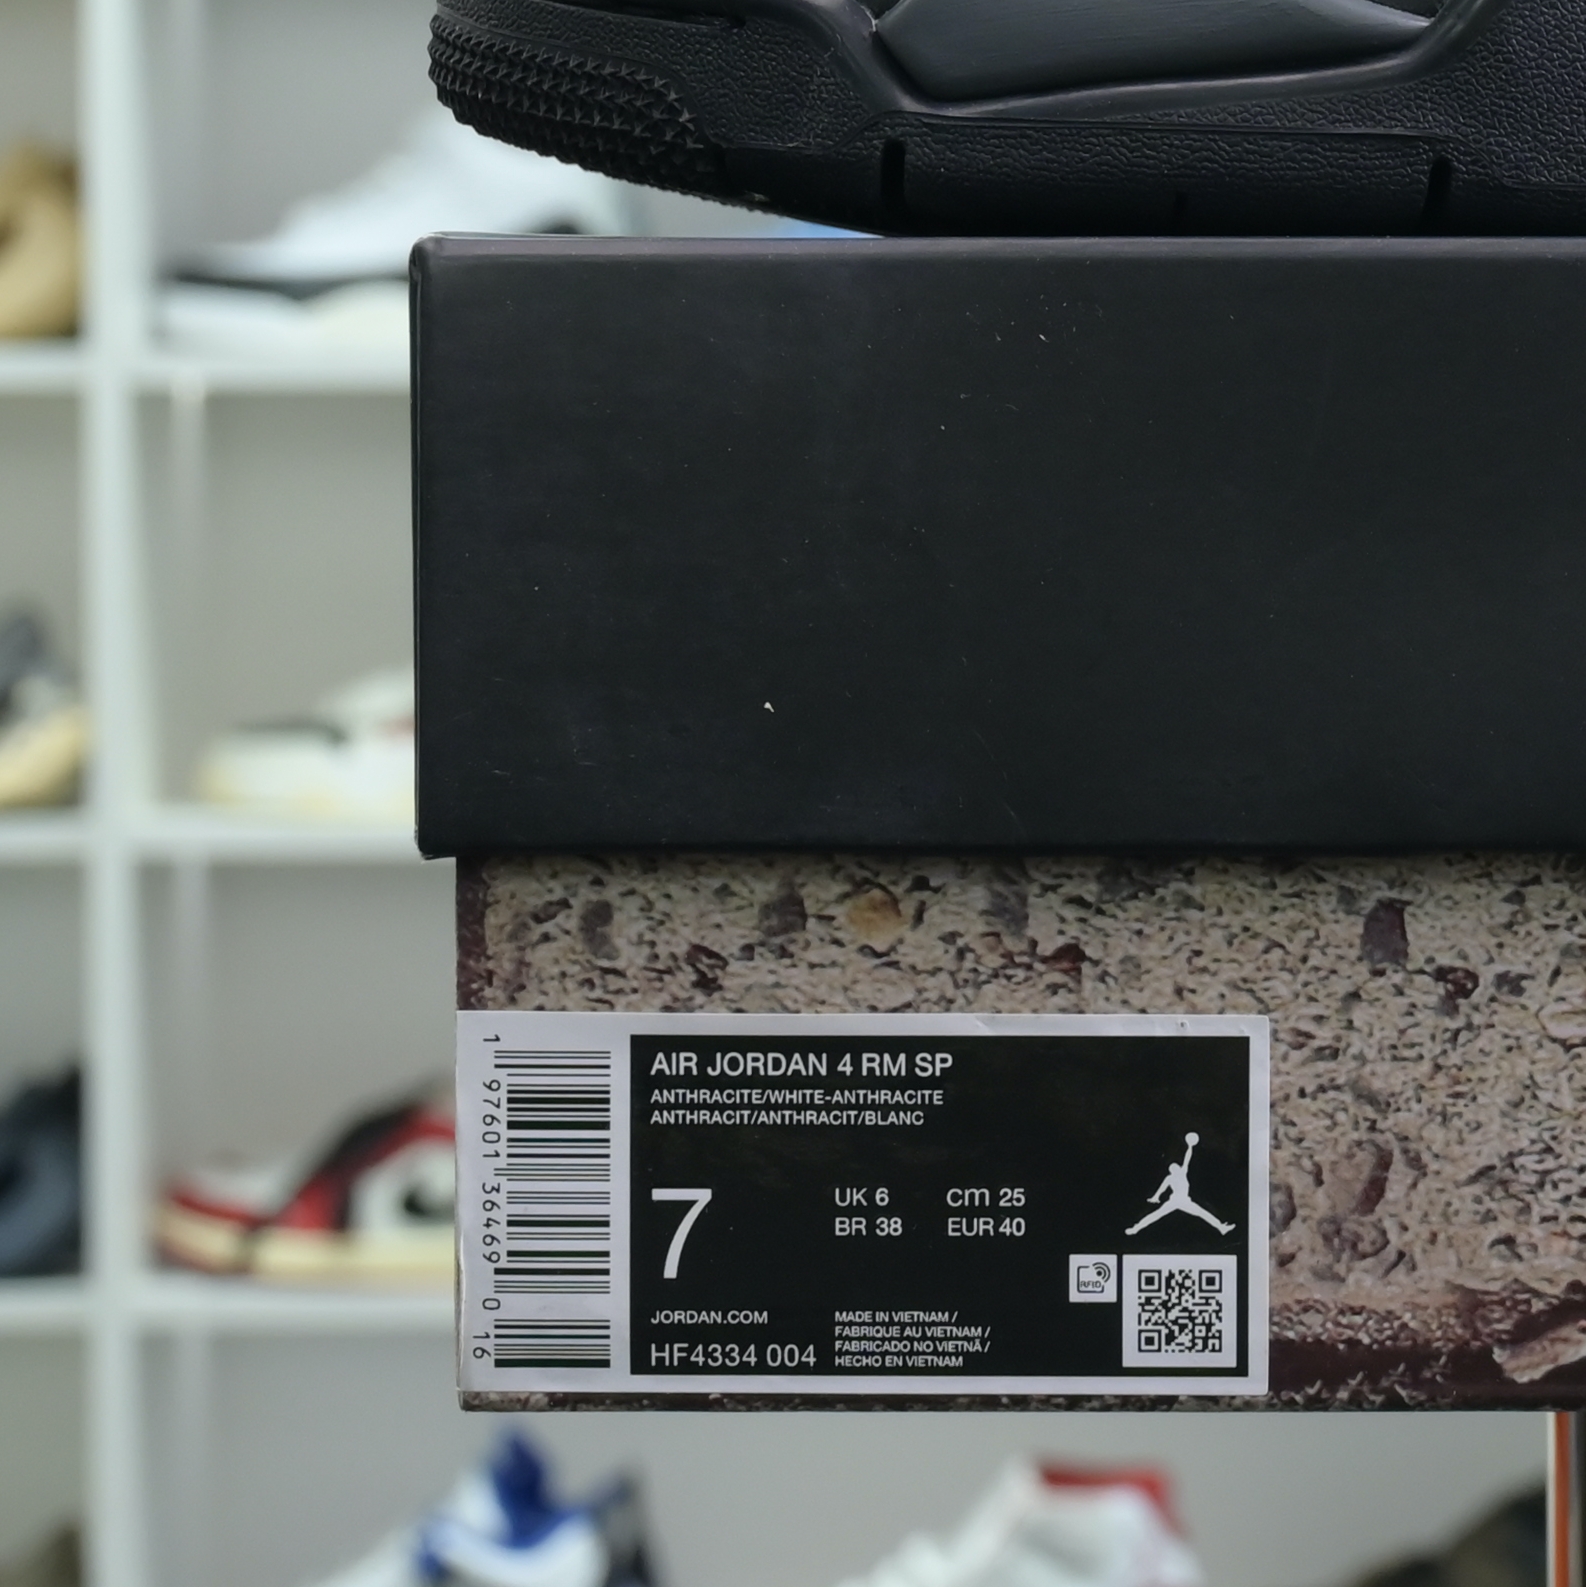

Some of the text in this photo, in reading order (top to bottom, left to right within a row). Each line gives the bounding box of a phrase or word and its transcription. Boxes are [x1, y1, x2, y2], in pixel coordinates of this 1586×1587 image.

[482, 1034, 501, 1042] 1
[649, 1051, 953, 1078] AIR JORDAN 4 RM SP
[650, 1088, 944, 1105] ANTHRACITE/WHITE-ANTHRACITE
[650, 1109, 925, 1126] ANTHRACIT/ANTHRACIT/BLANC
[482, 1079, 502, 1263] 97601 36469
[834, 1187, 890, 1207] UK 6
[998, 1187, 1026, 1207] 25
[651, 1187, 713, 1280] 7
[834, 1216, 903, 1237] BR 38
[947, 1216, 1026, 1237] EUR 40
[482, 1297, 501, 1311] 0
[650, 1309, 768, 1325] JORDAN.COM
[834, 1311, 873, 1323] MADE
[875, 1311, 889, 1323] IN
[892, 1311, 949, 1323] VIETNAM
[834, 1325, 901, 1338] FABRIQUE
[903, 1325, 922, 1338] AU
[925, 1325, 982, 1338] VIETNAM
[472, 1331, 492, 1359] 16
[834, 1340, 911, 1353] FABRICADO
[913, 1340, 934, 1353] NO
[936, 1338, 982, 1353] VIETNÃ
[650, 1342, 817, 1367] HF4334 004
[834, 1355, 964, 1368] HECHO EN VIETNAM
